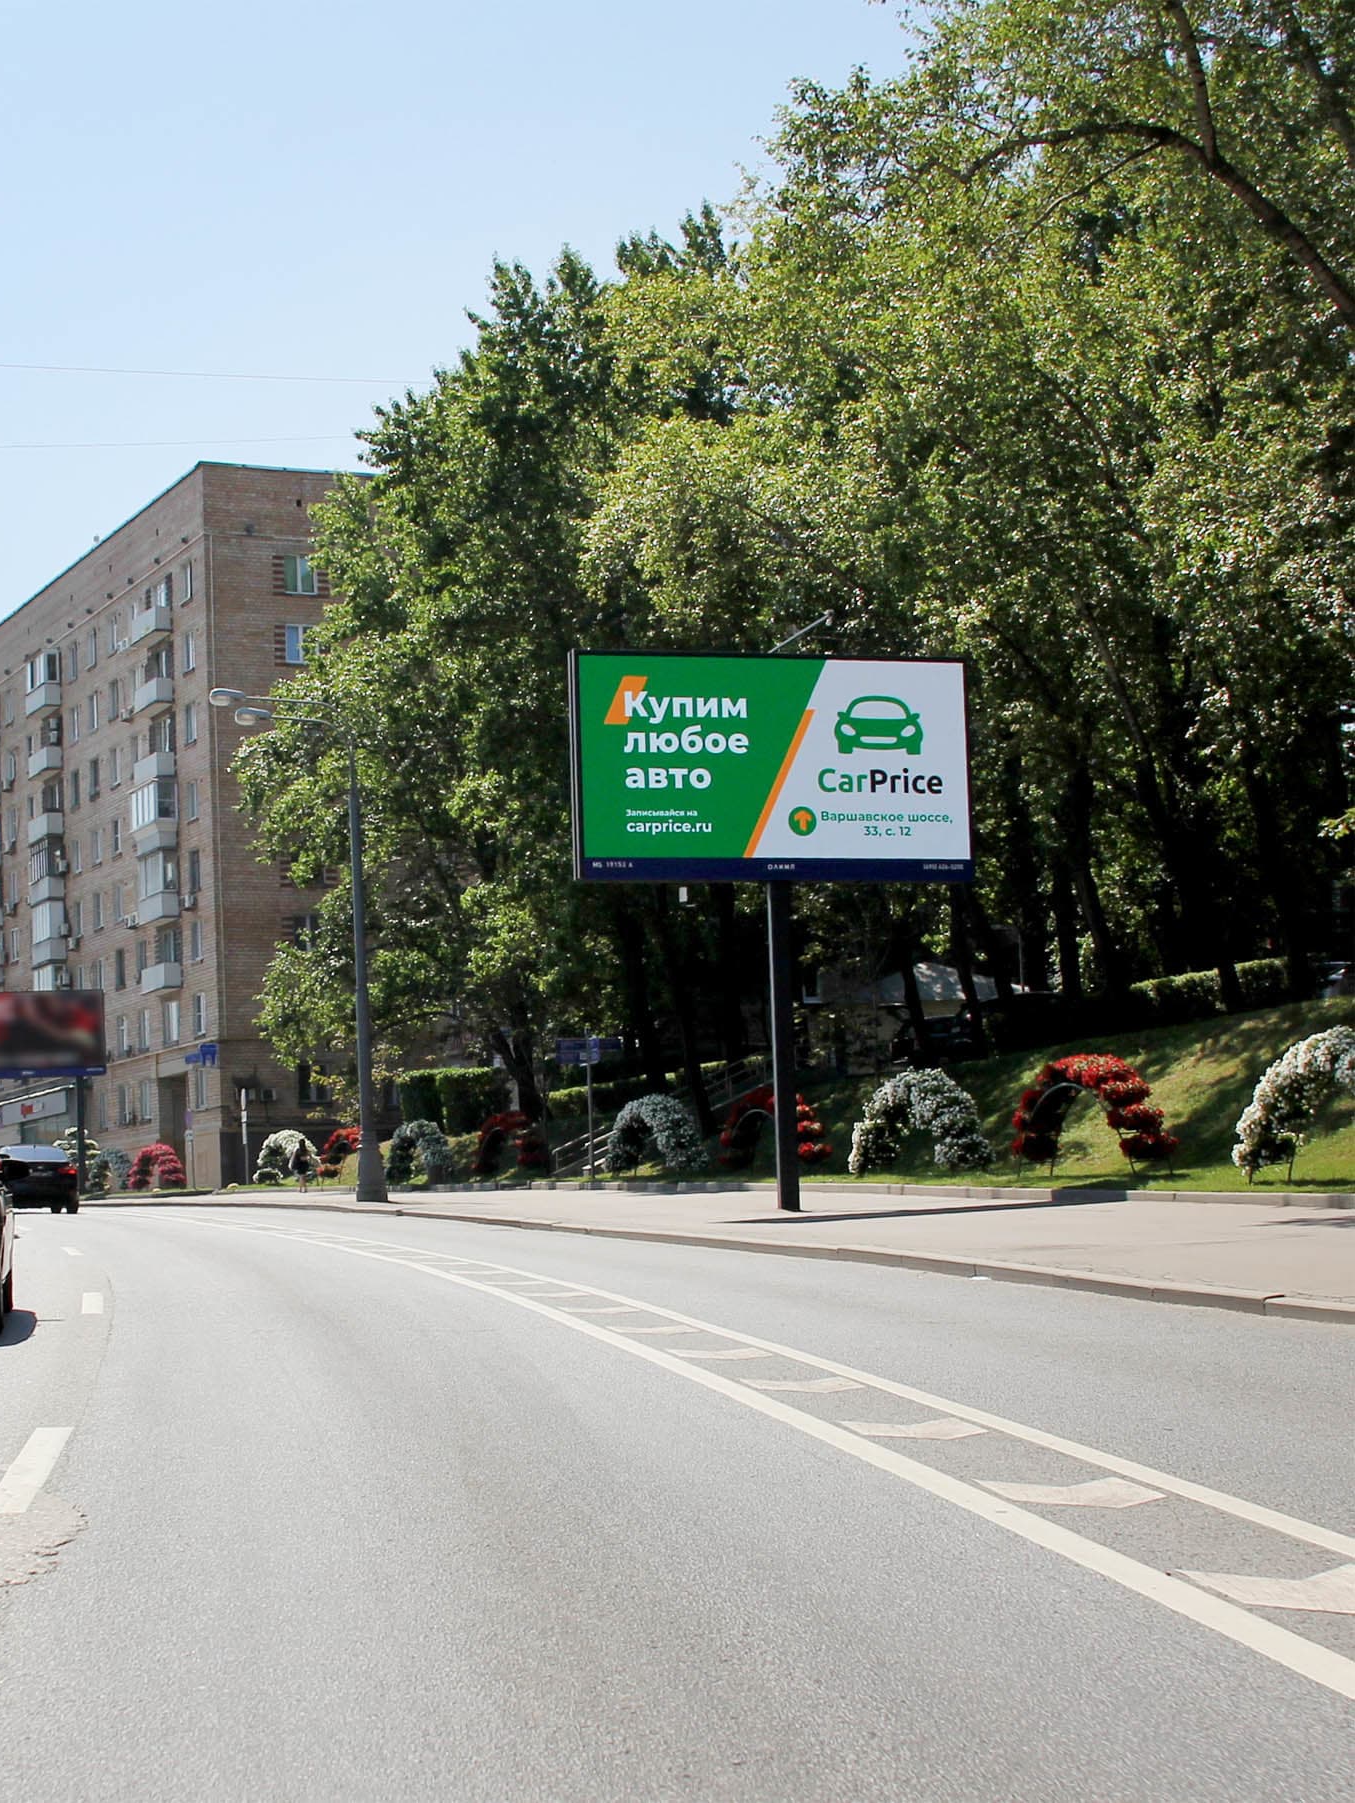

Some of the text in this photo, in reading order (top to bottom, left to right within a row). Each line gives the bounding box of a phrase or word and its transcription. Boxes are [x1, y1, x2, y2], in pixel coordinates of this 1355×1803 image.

[624, 691, 748, 724] Купим
[624, 725, 749, 754] любое
[625, 767, 712, 789] авто
[818, 768, 943, 794] CarPrice
[626, 809, 685, 817] Записывайся
[821, 811, 953, 825] Варшавское шоссе,
[626, 819, 713, 836] carprice.ru
[864, 826, 882, 837] 33,
[899, 826, 912, 837] 12
